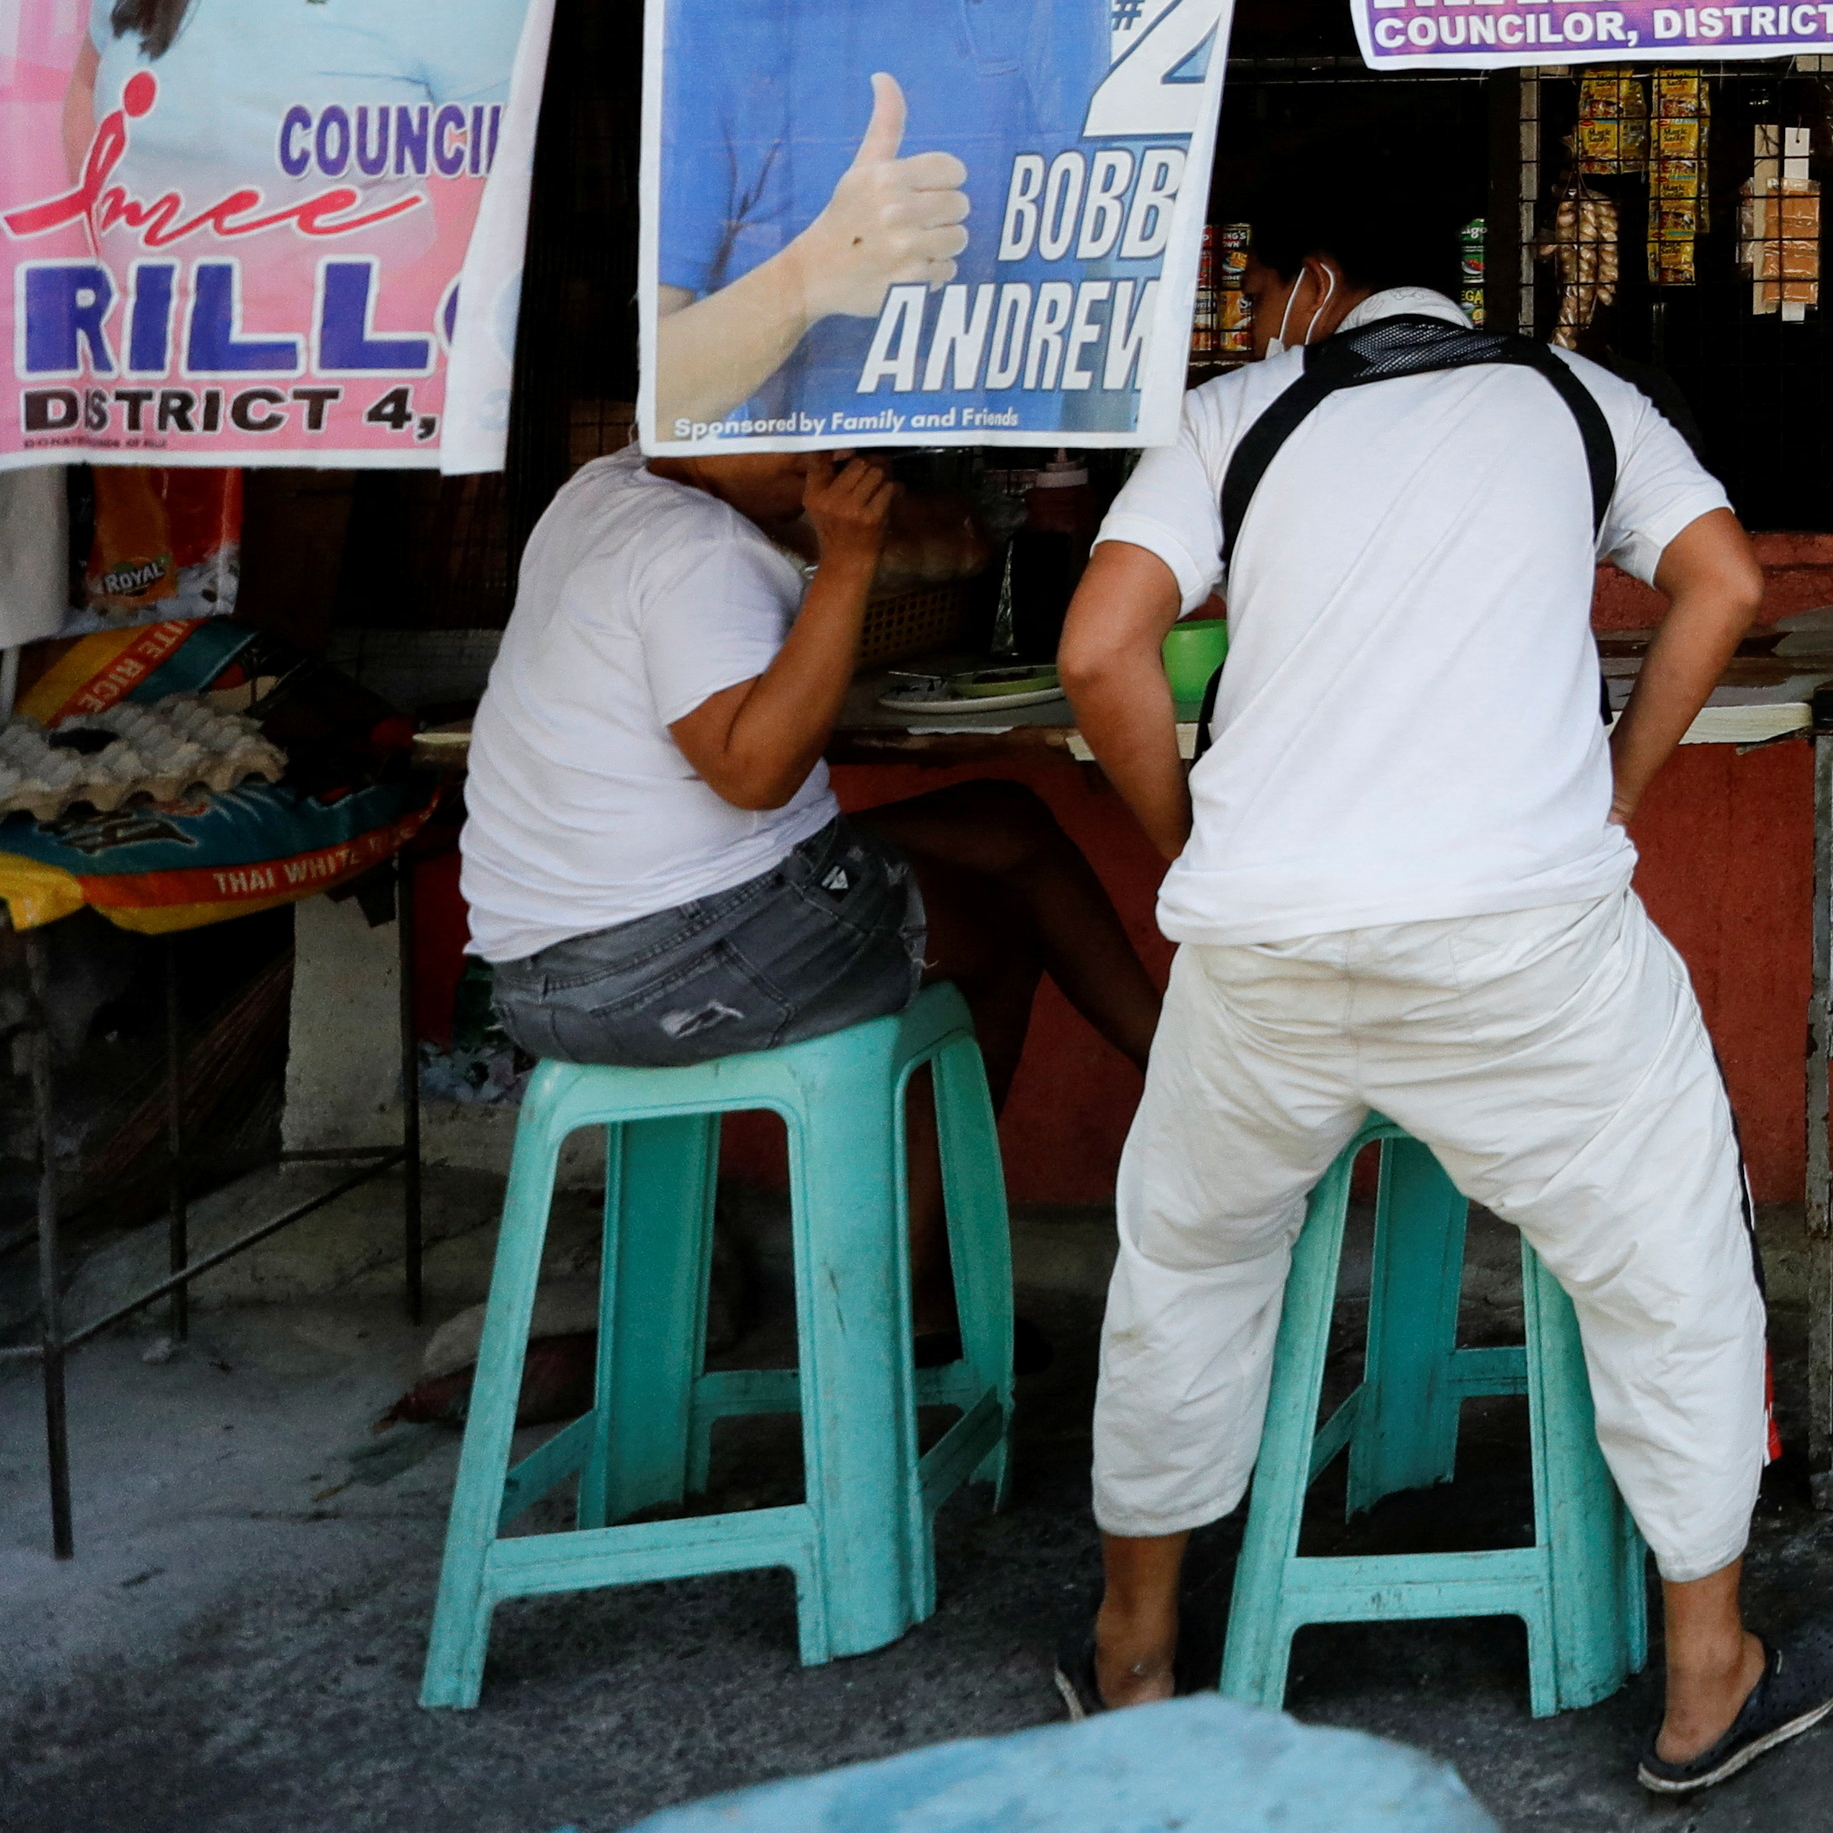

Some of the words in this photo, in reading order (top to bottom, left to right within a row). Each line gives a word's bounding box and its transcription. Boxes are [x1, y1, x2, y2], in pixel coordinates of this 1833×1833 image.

[1375, 11, 1640, 49] COUNCILOR,
[674, 411, 797, 438] Sponsored
[799, 411, 824, 436] by
[831, 408, 904, 435] Family
[911, 408, 955, 430] and
[961, 406, 1018, 429] Friends
[103, 563, 165, 595] ROYAL
[213, 870, 275, 894] THAI
